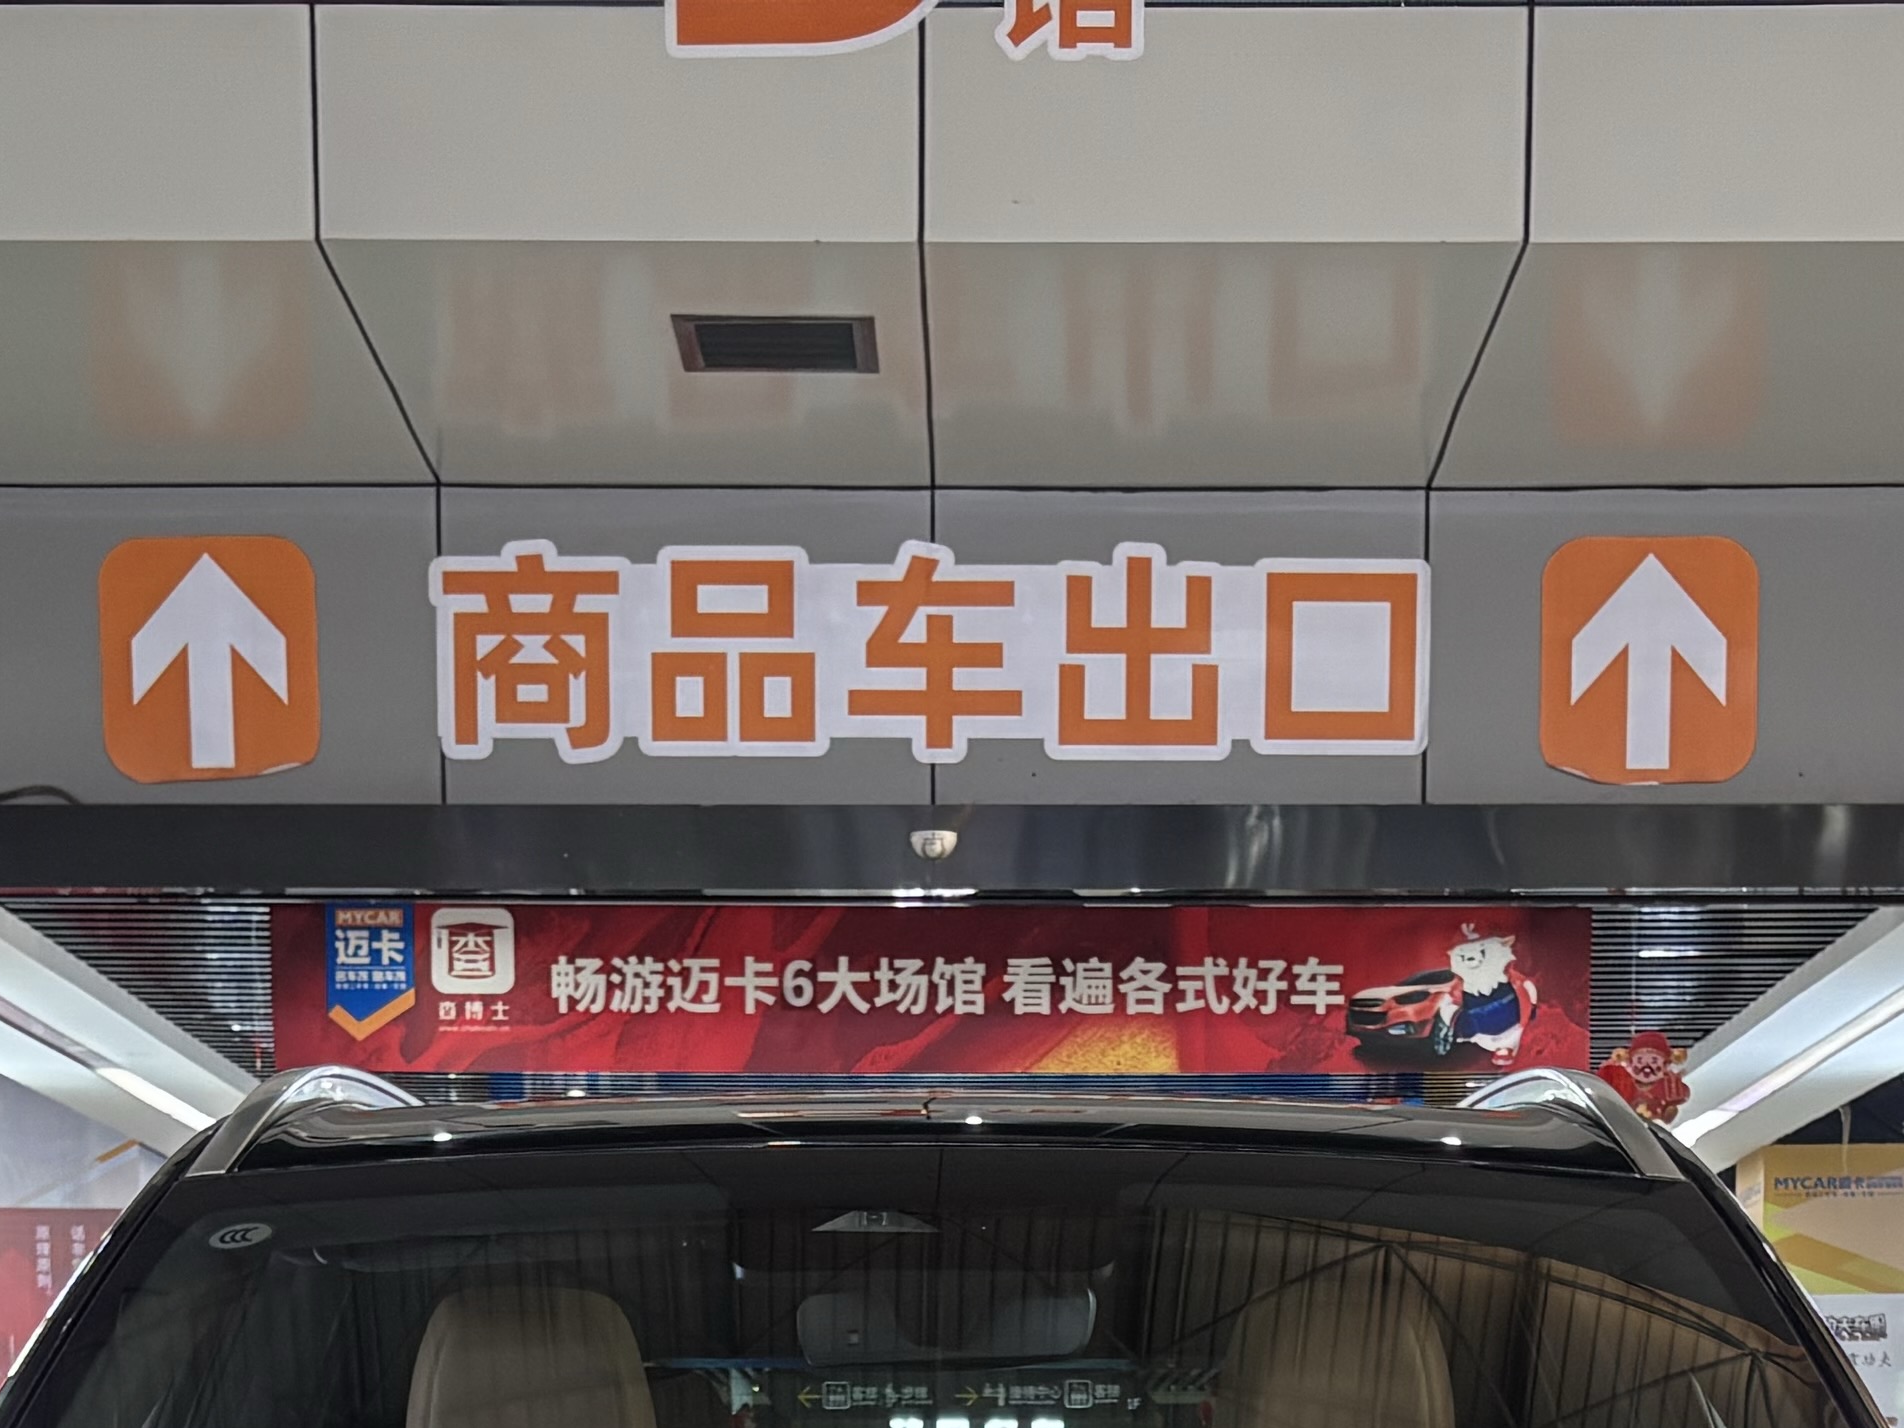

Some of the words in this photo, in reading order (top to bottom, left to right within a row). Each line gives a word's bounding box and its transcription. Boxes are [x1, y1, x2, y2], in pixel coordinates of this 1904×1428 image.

[441, 552, 1419, 750] 商品车出口
[337, 909, 401, 925] MYCAR
[334, 929, 406, 966] 迈卡
[549, 955, 986, 1017] 畅游迈卡6大场馆
[1001, 955, 1346, 1017] 看遍各式好车
[438, 1000, 510, 1021] 查博士
